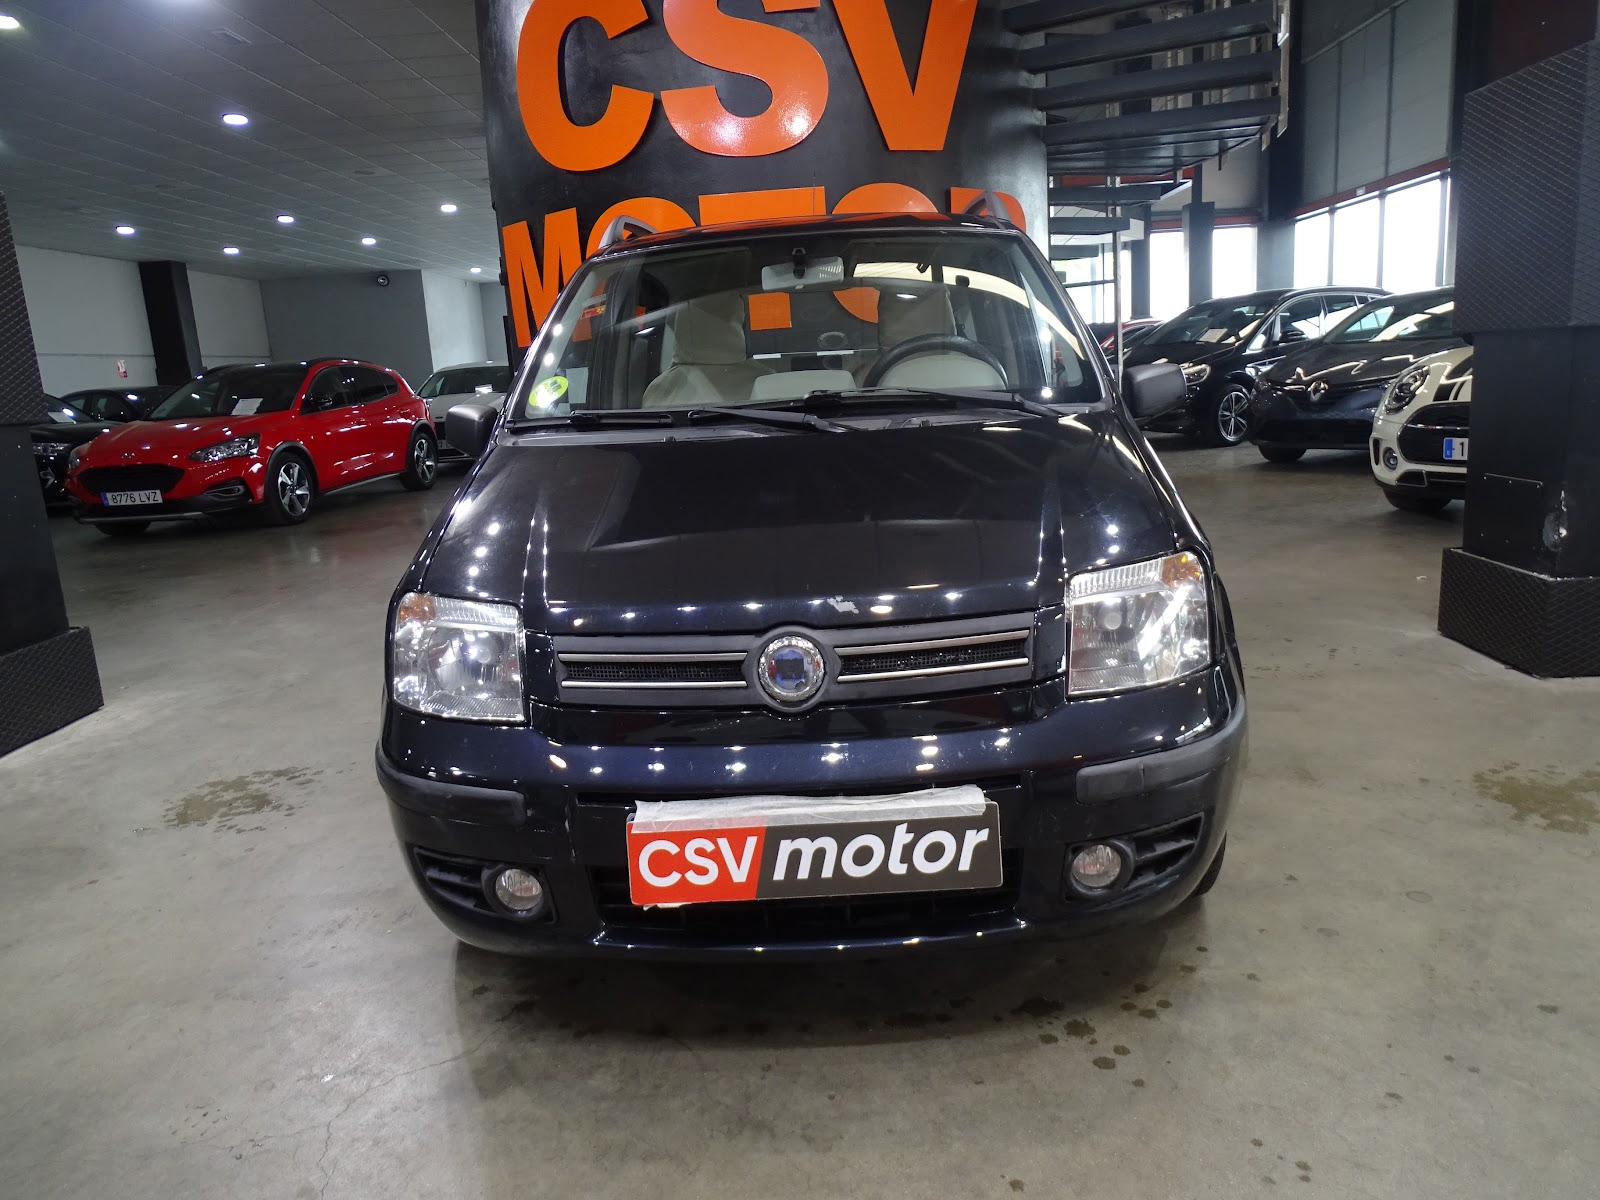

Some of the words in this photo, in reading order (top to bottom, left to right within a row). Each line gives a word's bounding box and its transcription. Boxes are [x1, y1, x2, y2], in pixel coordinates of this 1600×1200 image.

[517, 0, 977, 172] CSV
[111, 493, 136, 504] 8776
[139, 491, 159, 503] LVZ
[638, 835, 758, 887] CSV
[772, 822, 990, 881] motor
